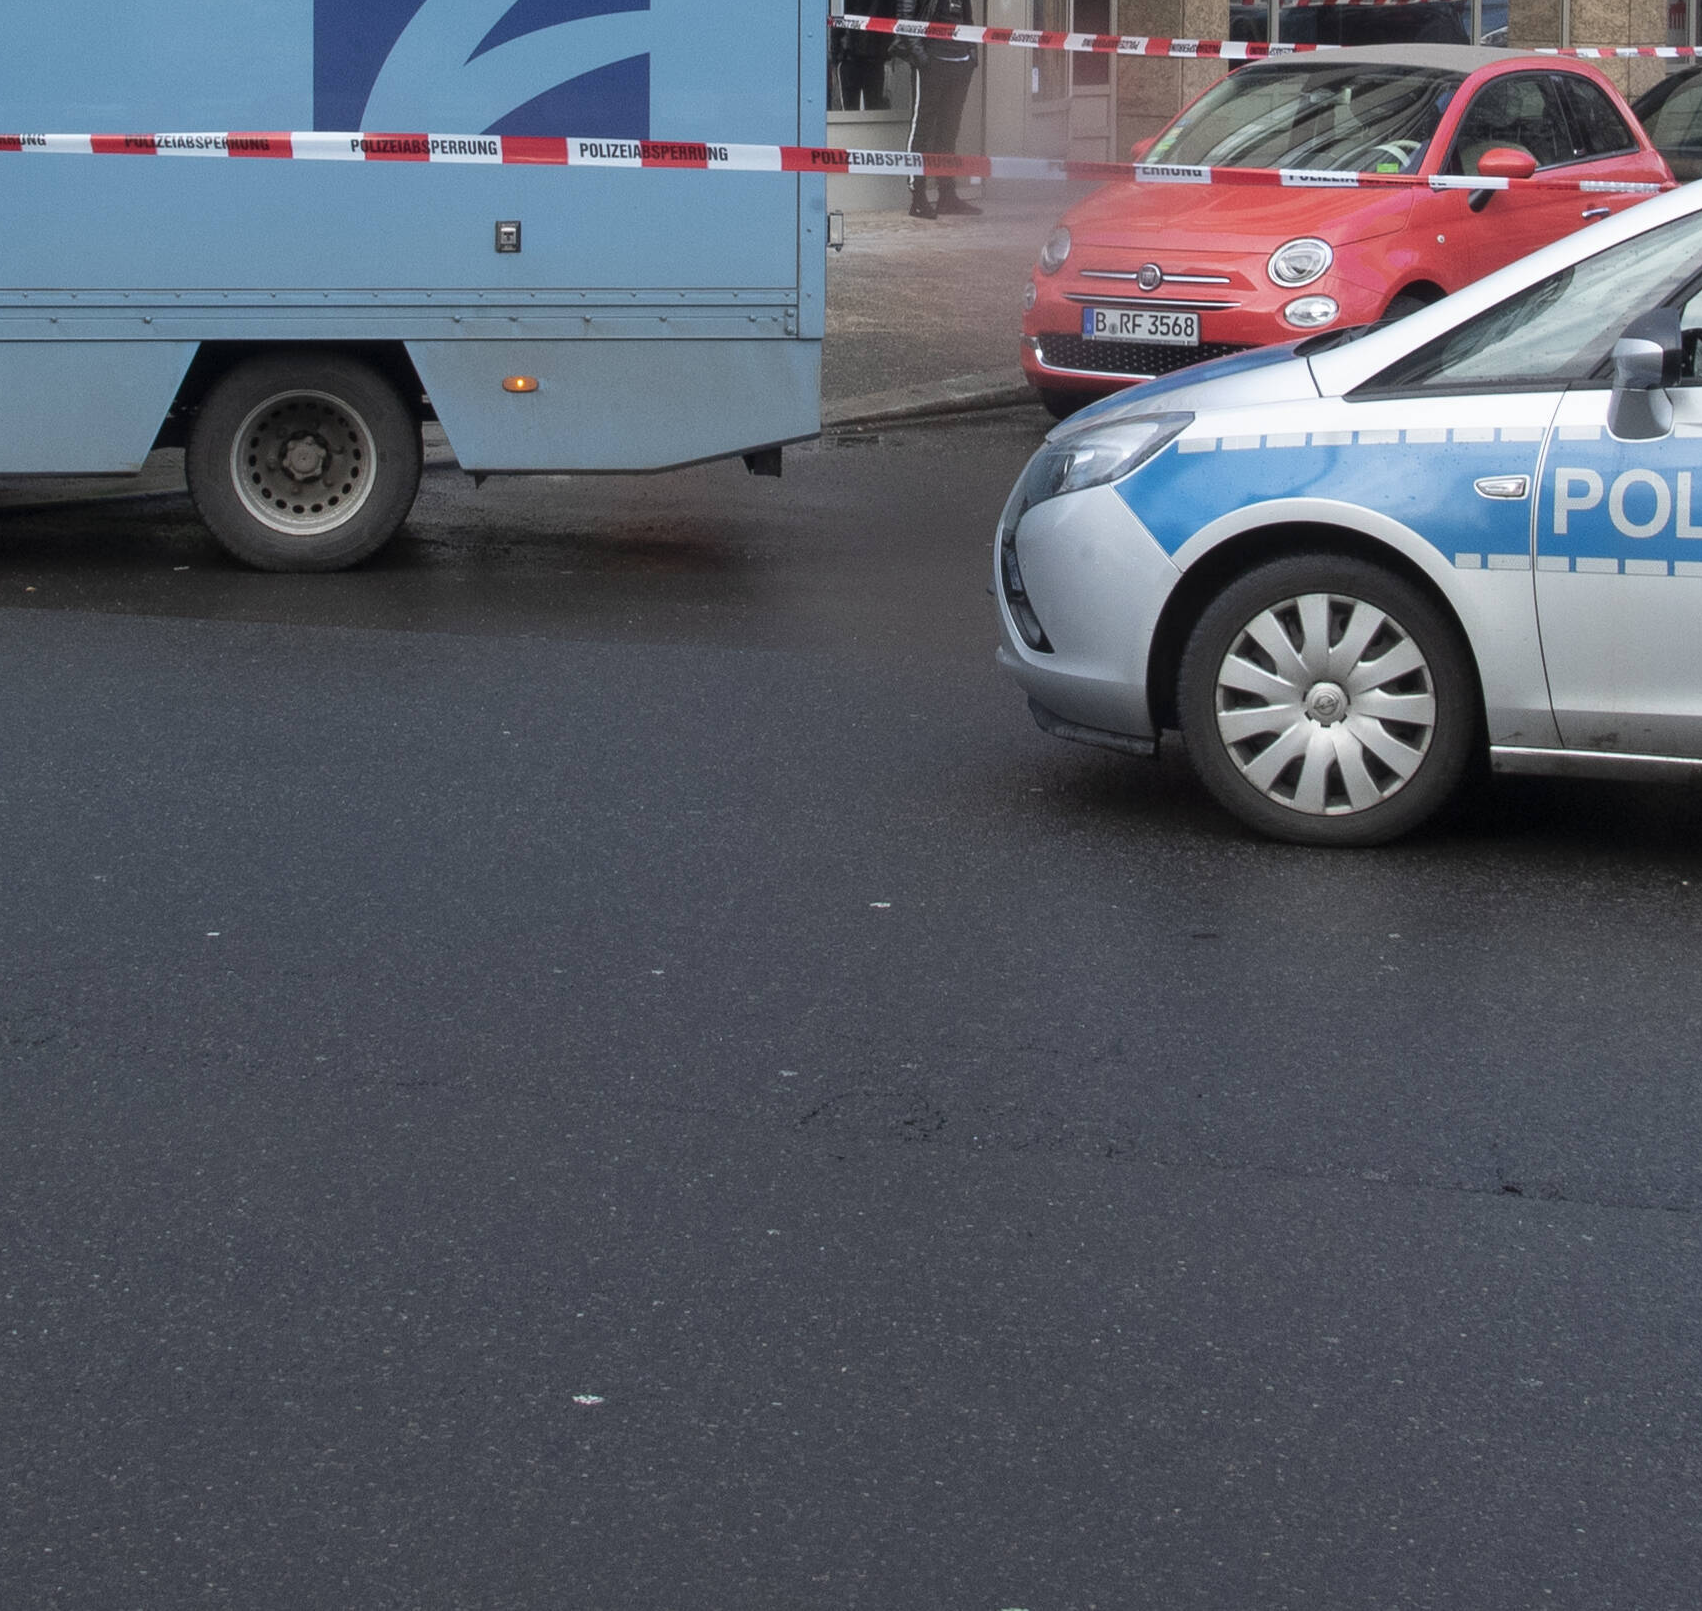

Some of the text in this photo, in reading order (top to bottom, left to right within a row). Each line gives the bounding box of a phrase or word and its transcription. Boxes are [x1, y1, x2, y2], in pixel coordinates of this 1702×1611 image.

[124, 134, 270, 152] POLIZEIABSPERRUNG
[350, 138, 499, 156] POLIZEIABSPERRUNG
[579, 142, 729, 162] POLIZEIABSPERRUNG
[811, 150, 963, 169] POLIZEIABSPERRUNG
[1095, 311, 1195, 337] B RF 3568
